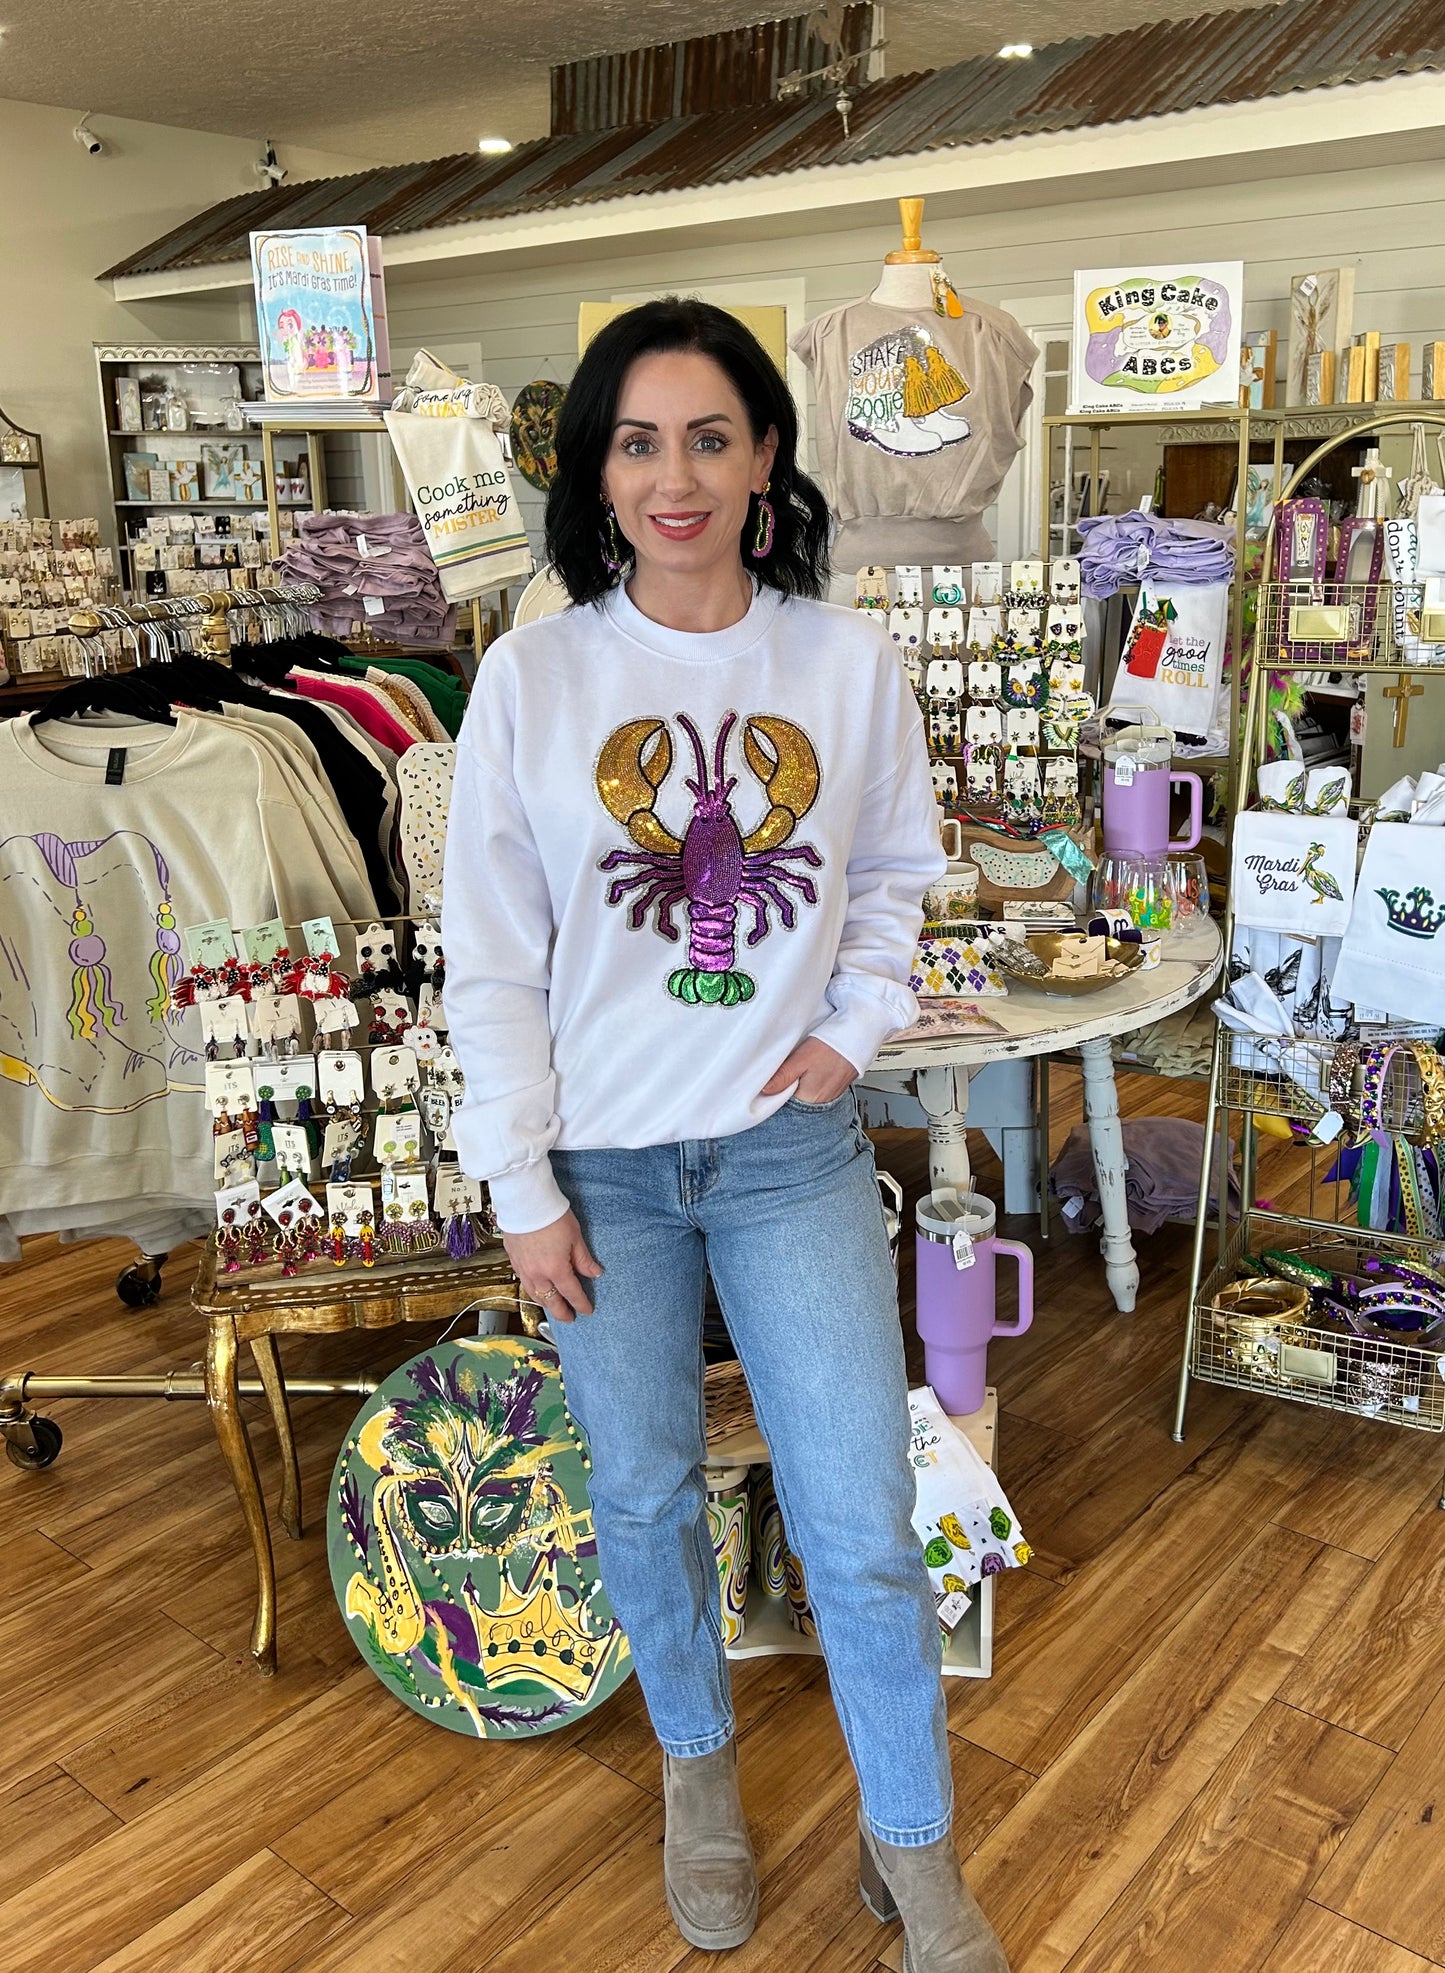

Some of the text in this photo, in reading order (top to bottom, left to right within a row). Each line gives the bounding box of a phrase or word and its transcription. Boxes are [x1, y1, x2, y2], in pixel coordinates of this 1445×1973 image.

[267, 246, 294, 271] RISE
[312, 250, 353, 274] SHINE,
[286, 270, 309, 287] Mardi
[311, 275, 331, 292] Gras
[333, 274, 357, 292] Time!
[1098, 284, 1219, 317] King Cake
[853, 341, 906, 376] SHAKE
[1122, 355, 1192, 376] ABCs
[417, 470, 506, 505] Cook me
[424, 493, 511, 531] something
[432, 508, 501, 539] MISTER
[1387, 521, 1404, 575] don't
[1186, 636, 1205, 647] the
[1161, 642, 1211, 667] good
[1172, 660, 1205, 673] times
[1161, 668, 1209, 689] ROLL
[1244, 855, 1301, 874] Mardi
[1256, 874, 1299, 895] Gras
[911, 1436, 941, 1452] the
